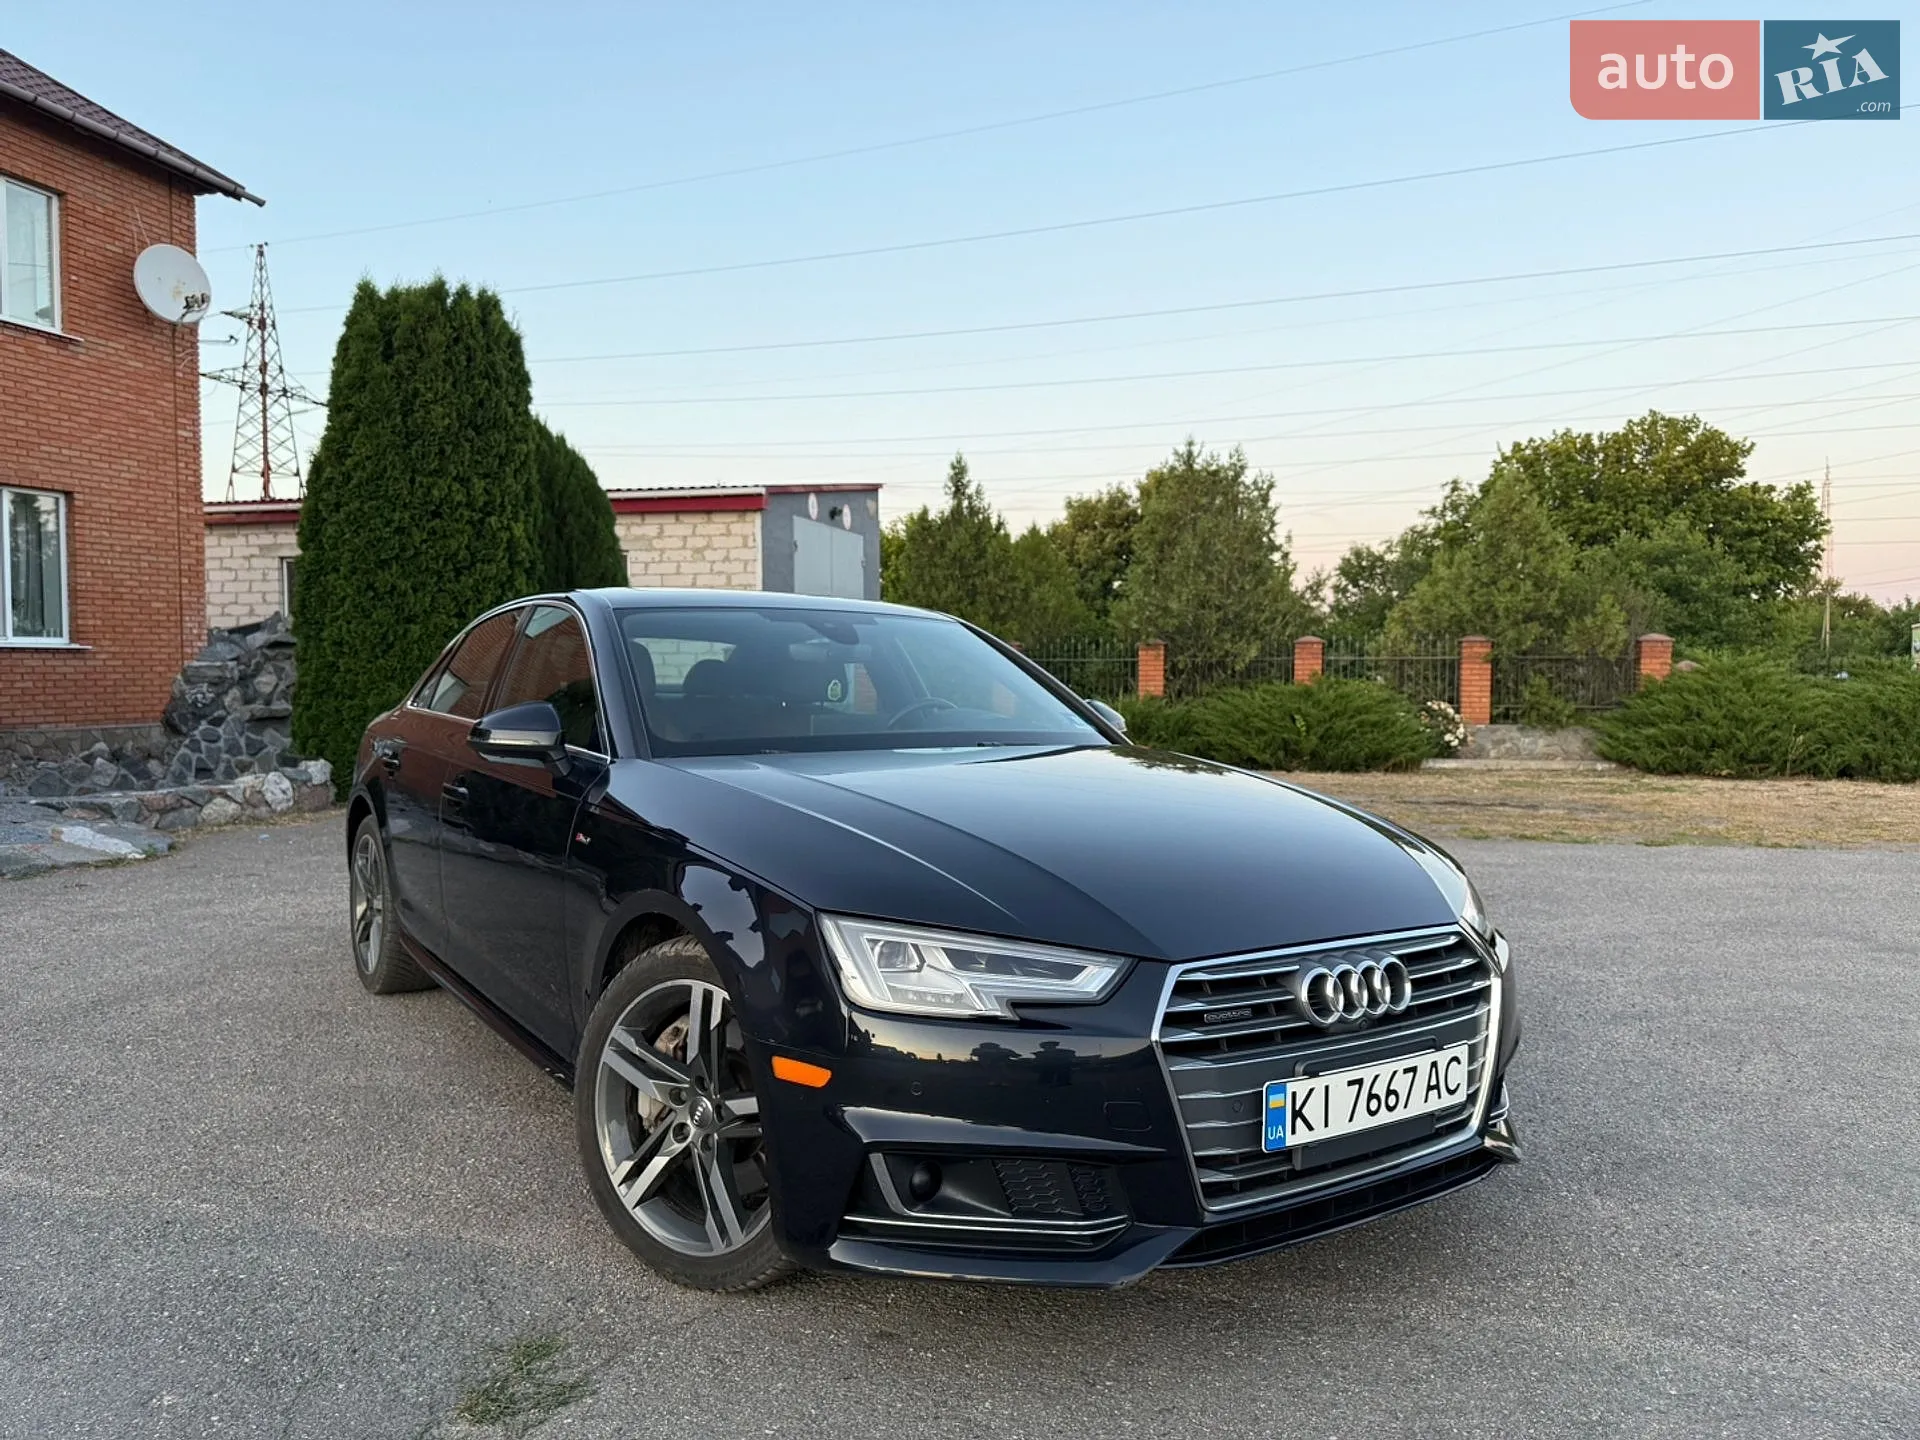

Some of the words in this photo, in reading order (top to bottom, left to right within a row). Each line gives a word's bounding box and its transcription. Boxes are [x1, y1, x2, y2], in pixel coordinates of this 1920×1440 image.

[1291, 1085, 1330, 1135] KI
[1347, 1066, 1418, 1123] 7667
[1423, 1056, 1461, 1103] AC
[1267, 1125, 1284, 1140] UA
